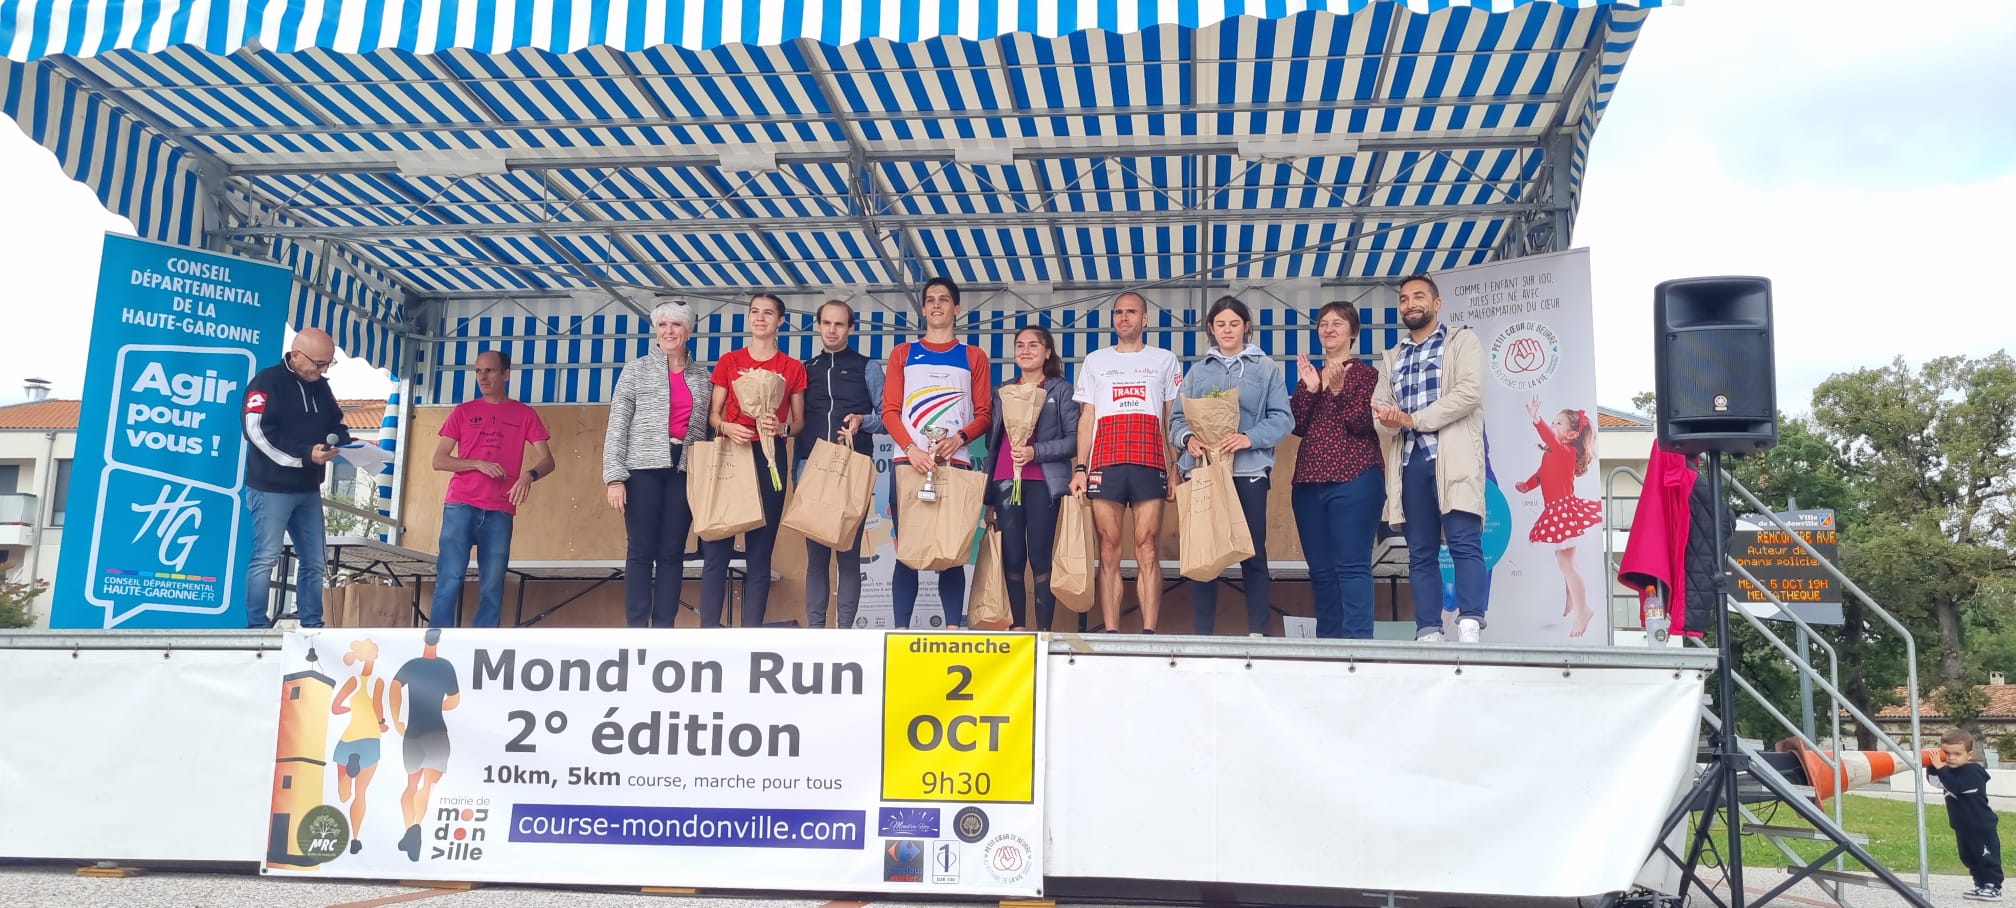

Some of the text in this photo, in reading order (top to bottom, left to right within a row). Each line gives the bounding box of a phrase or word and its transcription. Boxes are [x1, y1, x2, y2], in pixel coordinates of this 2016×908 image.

[167, 257, 231, 283] CONSEIL
[131, 269, 261, 307] DÉPARTEMENTAL
[1454, 283, 1482, 297] COMME
[1490, 277, 1518, 292] ENFANT
[1522, 275, 1535, 287] SUR
[1469, 287, 1539, 308] JULES EST NÉ AVEC
[173, 297, 216, 318] DE LA
[1450, 311, 1464, 323] UNE
[1468, 303, 1523, 320] MALFORMATION
[1526, 301, 1537, 312] DU
[121, 307, 260, 345] HAUTE-GARONNE
[1492, 334, 1506, 352] PETIT
[1527, 322, 1535, 331] DE
[1536, 324, 1558, 346] BEURRE
[131, 361, 237, 406] Agir
[1113, 387, 1145, 398] TRACKS
[1528, 380, 1537, 389] LA
[1536, 373, 1548, 385] VIE
[126, 402, 206, 429] pour
[126, 428, 221, 457] vous !
[880, 443, 892, 453] 02
[131, 484, 202, 573] HG
[1736, 557, 1772, 566] omans
[1747, 546, 1806, 555] Auteur de
[103, 584, 215, 602] HAUTE-GARONNE.FR
[104, 576, 215, 592] CONSEIL DÉPARTEMENTAL
[1782, 579, 1802, 589] OCT
[1808, 579, 1829, 589] 19H
[909, 638, 1011, 654] dimanche
[472, 648, 864, 695] Mond'on Run
[945, 665, 974, 701] 2
[591, 706, 800, 758] édition
[907, 715, 1010, 752] OCT
[483, 765, 842, 793] 10km, 5km course, marche pour tous
[922, 771, 991, 796] 9h30
[439, 796, 490, 806] mairie de
[518, 812, 857, 841] course-mondonville.com
[308, 838, 338, 852] MRC
[939, 843, 949, 873] 1
